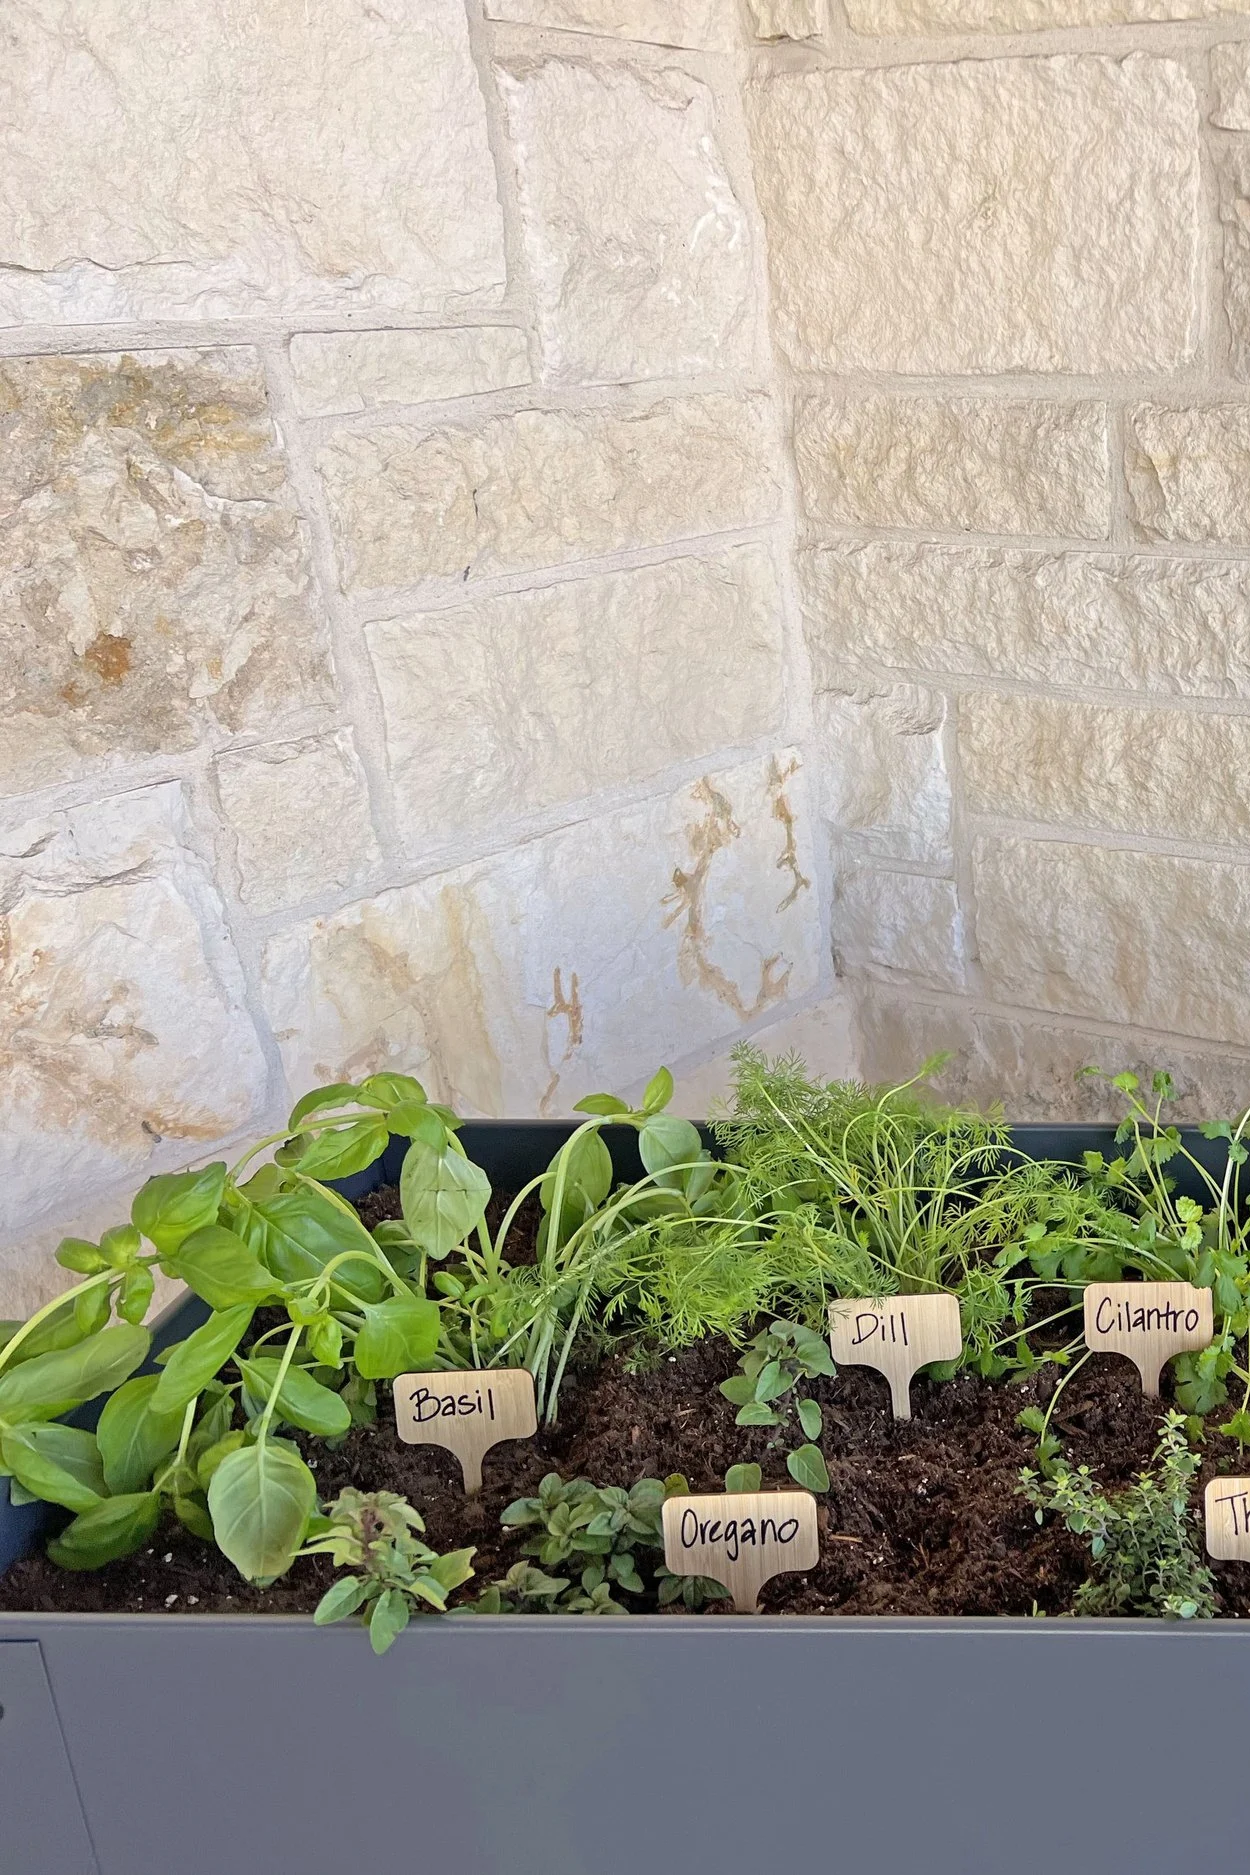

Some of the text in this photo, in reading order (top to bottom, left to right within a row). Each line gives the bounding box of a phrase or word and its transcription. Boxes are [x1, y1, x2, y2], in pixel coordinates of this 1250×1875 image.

[851, 1312, 909, 1346] Dill
[1095, 1296, 1199, 1334] Cilantro
[409, 1386, 496, 1423] Basil
[680, 1507, 799, 1562] Oregano
